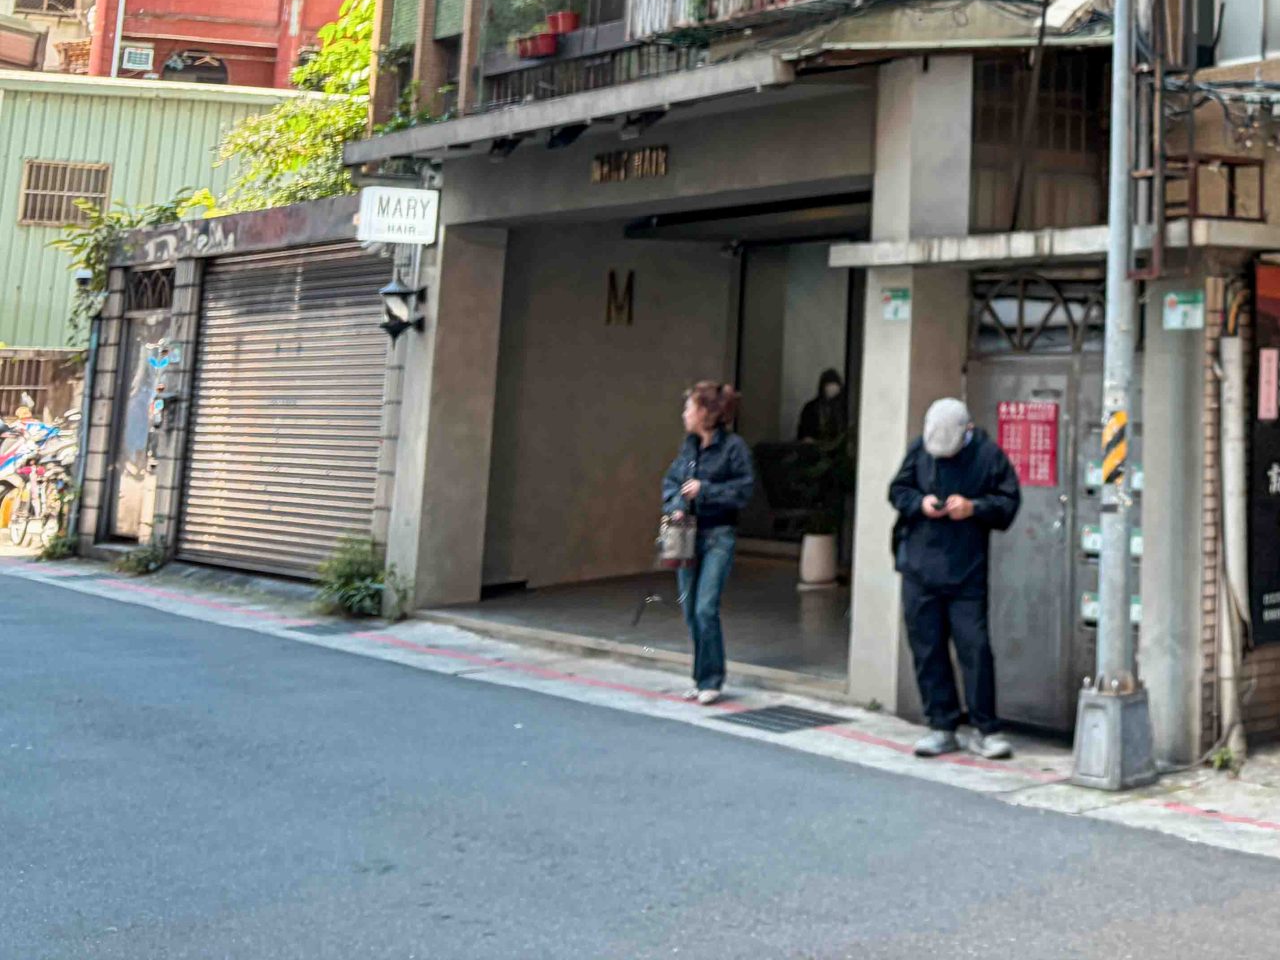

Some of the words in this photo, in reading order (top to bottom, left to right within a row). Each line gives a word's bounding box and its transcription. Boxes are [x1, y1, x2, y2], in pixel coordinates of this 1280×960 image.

[377, 196, 431, 221] MARY
[387, 224, 417, 235] HAIR
[604, 268, 635, 326] M
